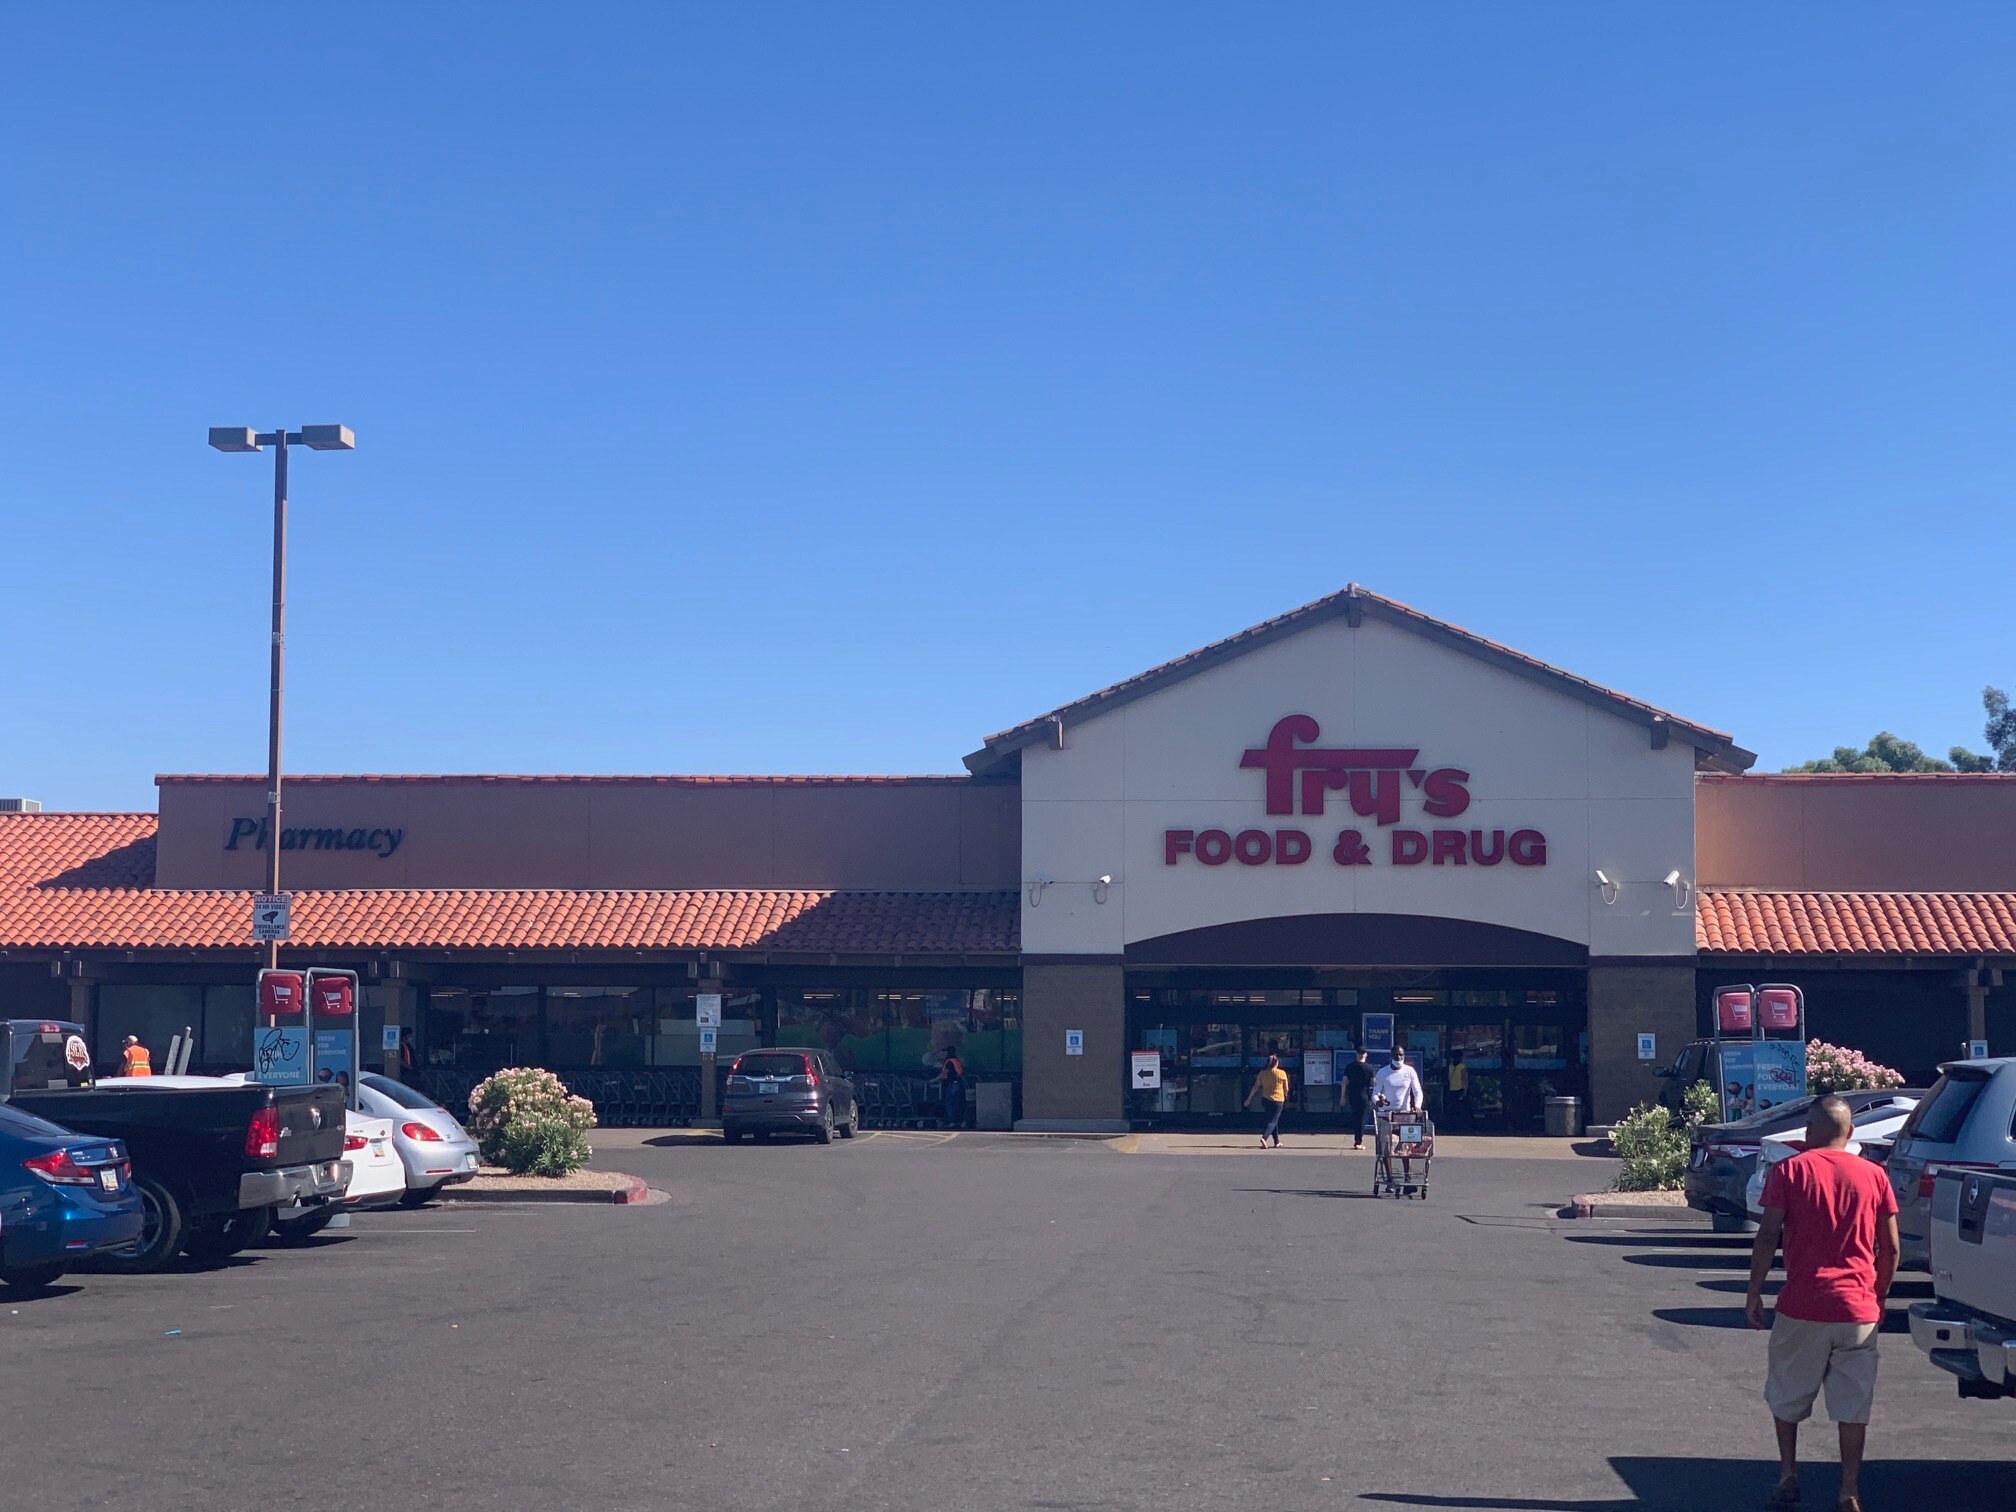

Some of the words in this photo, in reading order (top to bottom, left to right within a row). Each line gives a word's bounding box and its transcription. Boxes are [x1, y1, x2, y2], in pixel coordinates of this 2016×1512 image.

[1239, 714, 1470, 826] fry's
[1165, 829, 1312, 866] FOOD
[1333, 829, 1372, 866] &
[1392, 829, 1547, 866] DRUG
